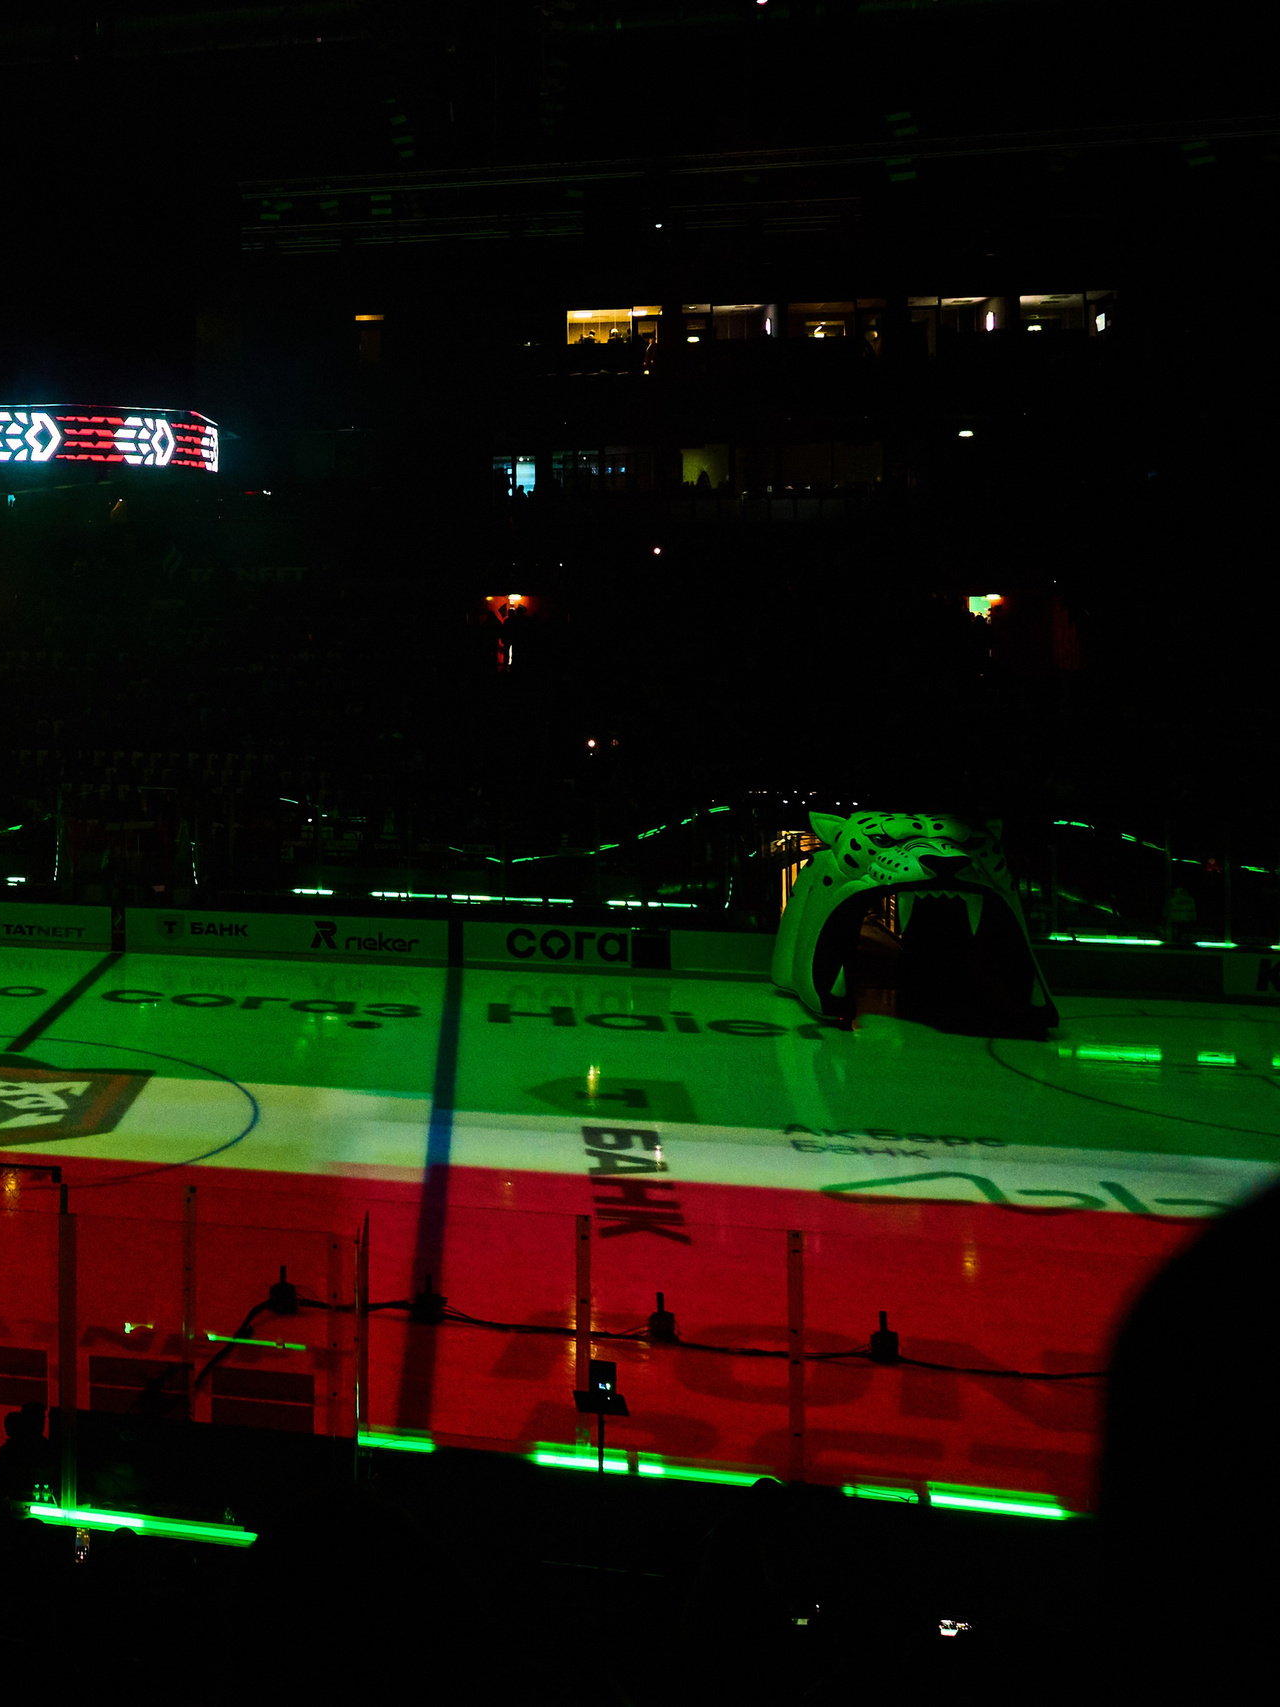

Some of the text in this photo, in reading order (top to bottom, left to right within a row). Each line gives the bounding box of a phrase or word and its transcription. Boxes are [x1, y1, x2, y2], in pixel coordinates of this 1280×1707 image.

[3, 923, 86, 939] TATNEFT
[190, 921, 249, 938] БАНК
[345, 933, 419, 953] rieker
[506, 927, 630, 962] сога
[101, 989, 422, 1019] согаз
[581, 1125, 695, 1246] БАНК
